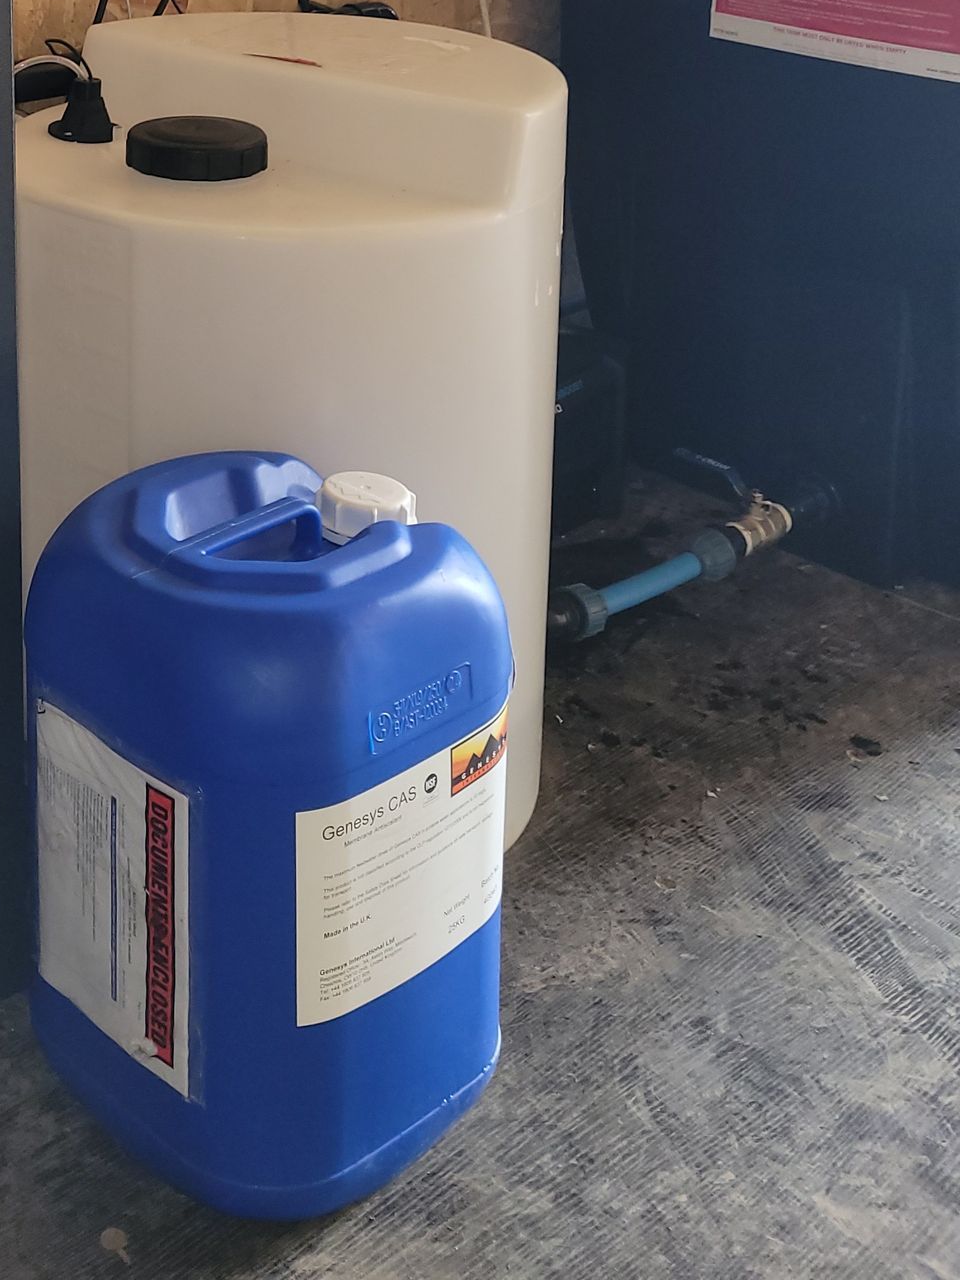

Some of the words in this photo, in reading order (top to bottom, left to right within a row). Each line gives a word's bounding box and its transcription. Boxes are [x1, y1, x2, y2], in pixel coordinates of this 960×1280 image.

[322, 806, 384, 840] Genesys
[388, 787, 417, 812] CAS
[149, 801, 169, 936] DOCUMENT
[323, 927, 341, 939] Made
[349, 919, 359, 929] the
[319, 961, 347, 976] Genesys
[348, 941, 384, 965] International
[150, 936, 169, 1049] ENCLOSED
